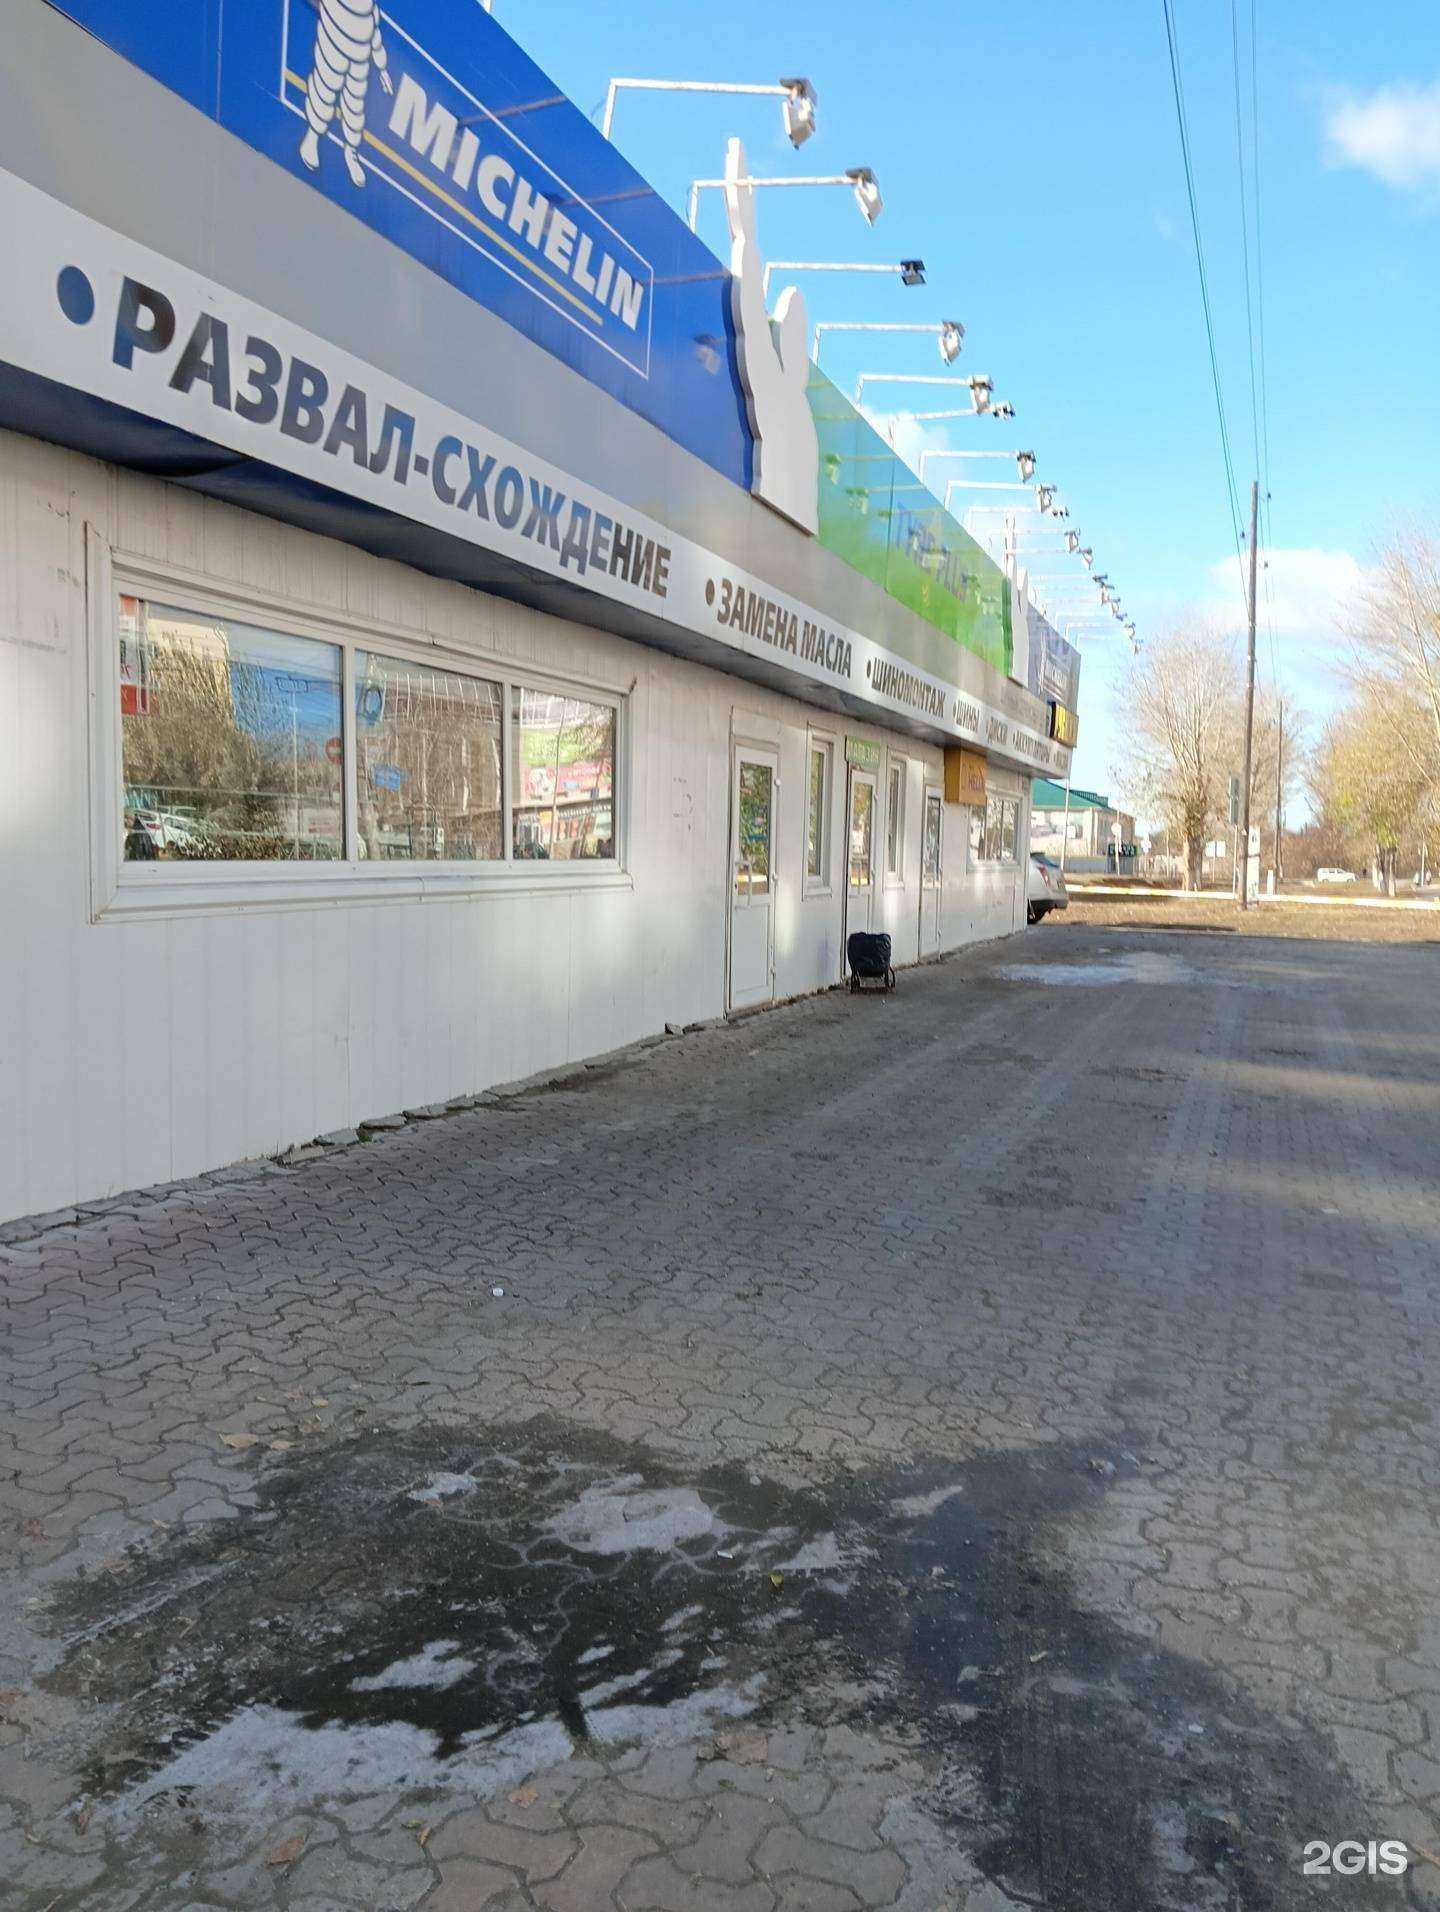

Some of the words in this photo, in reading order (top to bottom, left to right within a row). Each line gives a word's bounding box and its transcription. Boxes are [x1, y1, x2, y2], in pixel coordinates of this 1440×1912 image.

[389, 73, 644, 331] MICHELIN
[112, 275, 672, 598] РАЗВАЛ-СХОЖДЕНИЕ
[717, 578, 798, 655] ЗАМЕНА
[801, 620, 852, 679] МАСЛА
[871, 657, 946, 718] ШИНОМОНТАЖ
[955, 700, 980, 733] ШИНЫ
